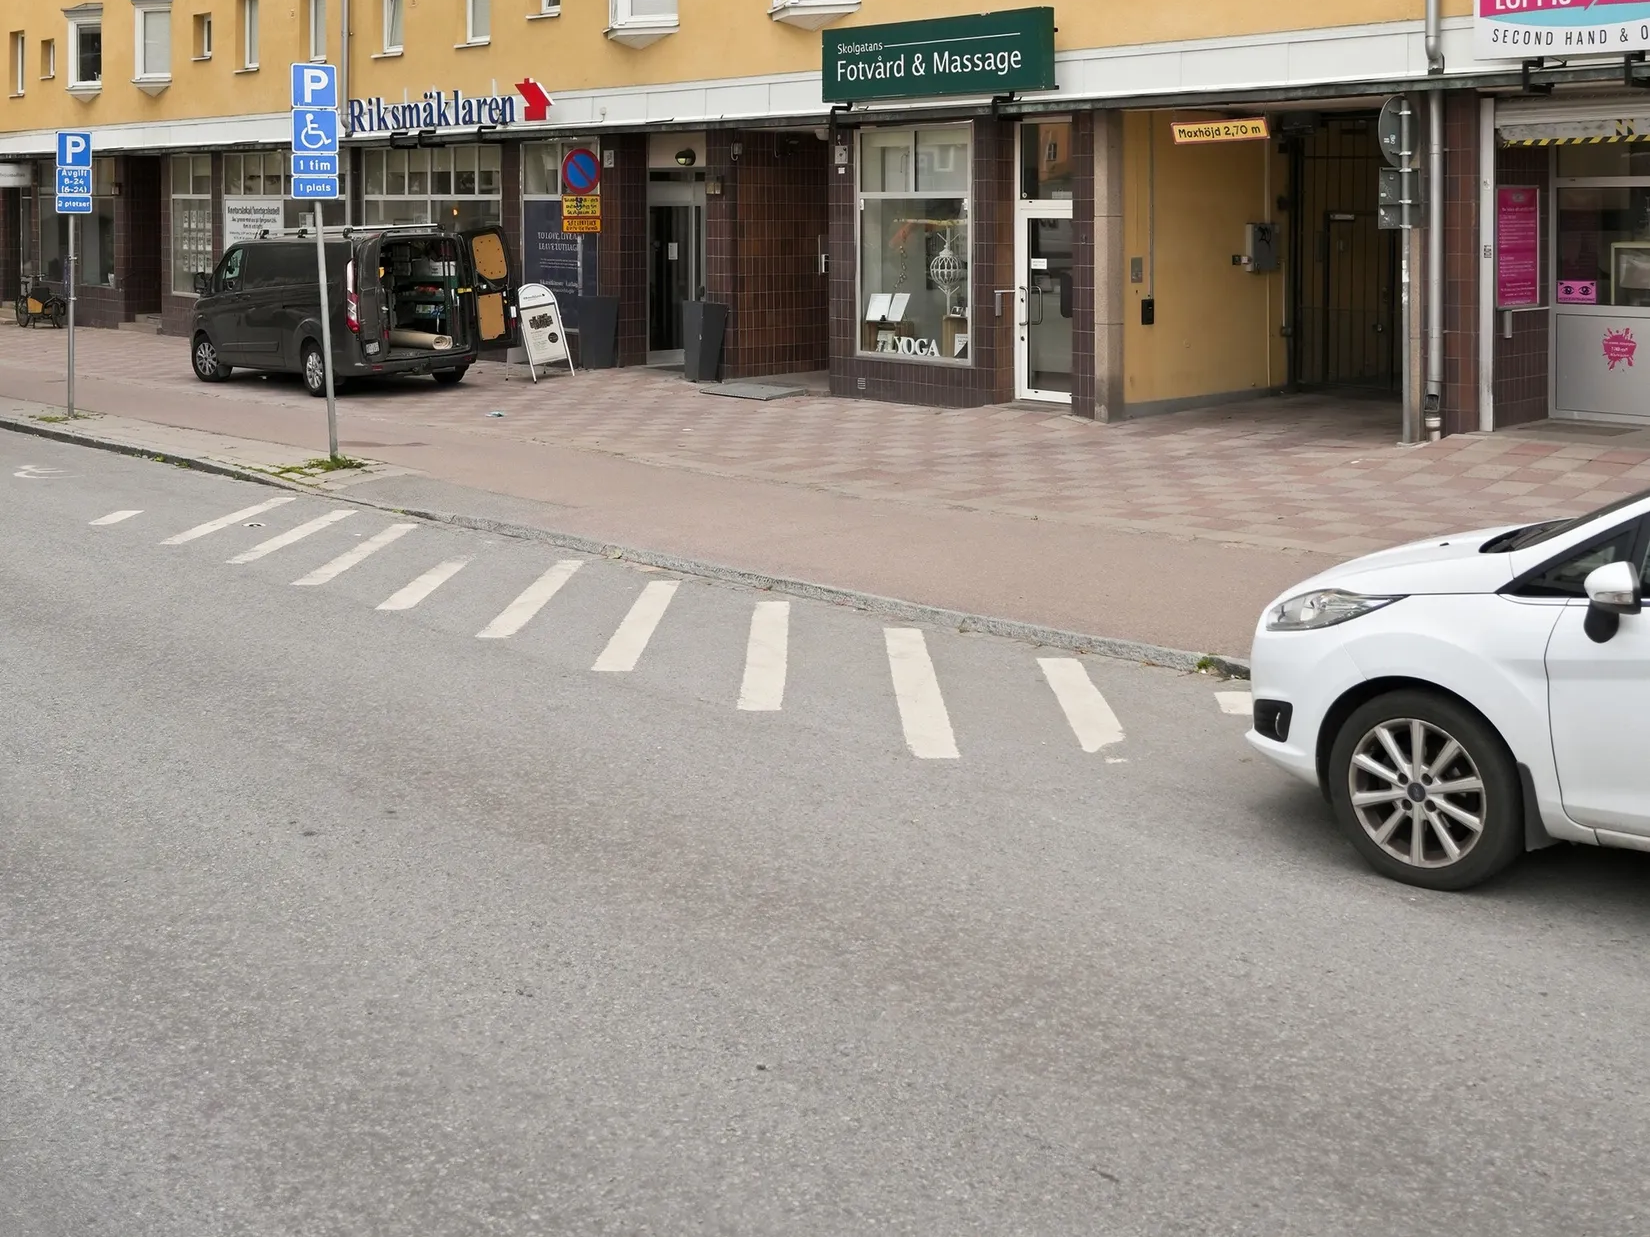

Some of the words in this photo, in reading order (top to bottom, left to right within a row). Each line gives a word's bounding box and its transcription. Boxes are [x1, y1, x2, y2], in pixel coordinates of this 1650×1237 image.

[1492, 28, 1553, 45] SECOND
[1565, 29, 1607, 45] HAND
[1619, 28, 1629, 42] &
[837, 42, 883, 56] Skolgatans
[837, 54, 905, 81] Fotvård
[911, 53, 926, 77] &
[933, 49, 1022, 75] Massage
[303, 68, 329, 103] P
[349, 90, 516, 133] Riksmäklaren
[1178, 127, 1221, 138] Maxhöjd
[1223, 124, 1248, 137] 2,70
[1251, 125, 1261, 134] m
[66, 135, 86, 164] P
[300, 160, 304, 171] 1
[309, 159, 331, 171] tim
[306, 183, 331, 193] plats
[894, 336, 940, 357] YOGA
